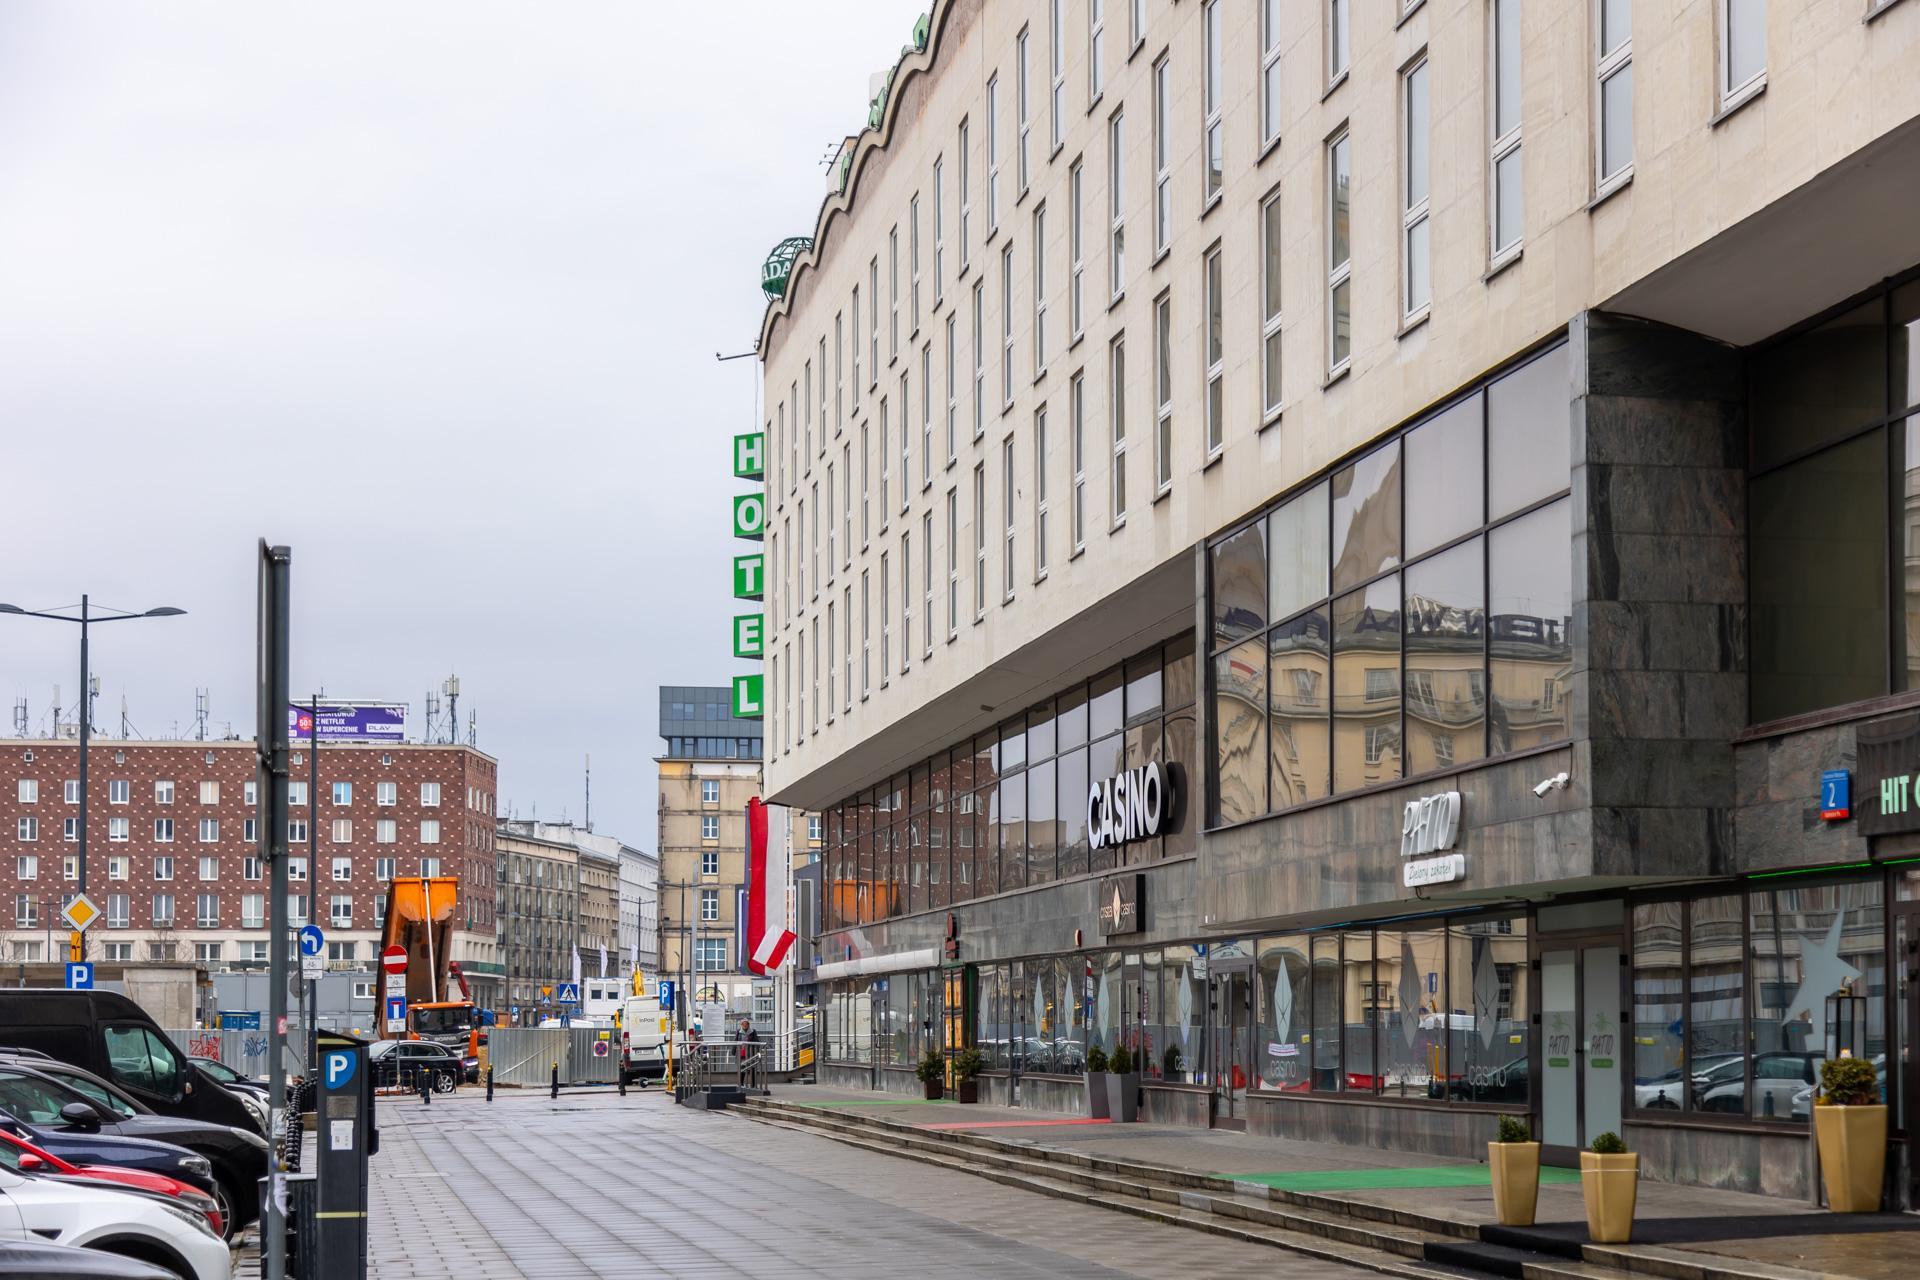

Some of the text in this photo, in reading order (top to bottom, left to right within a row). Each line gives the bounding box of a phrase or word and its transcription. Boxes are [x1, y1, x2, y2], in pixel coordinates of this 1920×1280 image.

[738, 436, 763, 713] HOTEL
[1088, 761, 1161, 849] CASINO
[1828, 783, 1836, 808] 2
[1881, 775, 1909, 815] HIT
[1401, 792, 1458, 856] PATIO
[72, 965, 88, 989] P
[661, 986, 669, 1004] P
[1548, 1034, 1570, 1055] PATIO
[1591, 1034, 1614, 1055] PATIO
[330, 1055, 348, 1082] P
[1269, 1059, 1297, 1079] casino
[1468, 1064, 1507, 1087] casino
